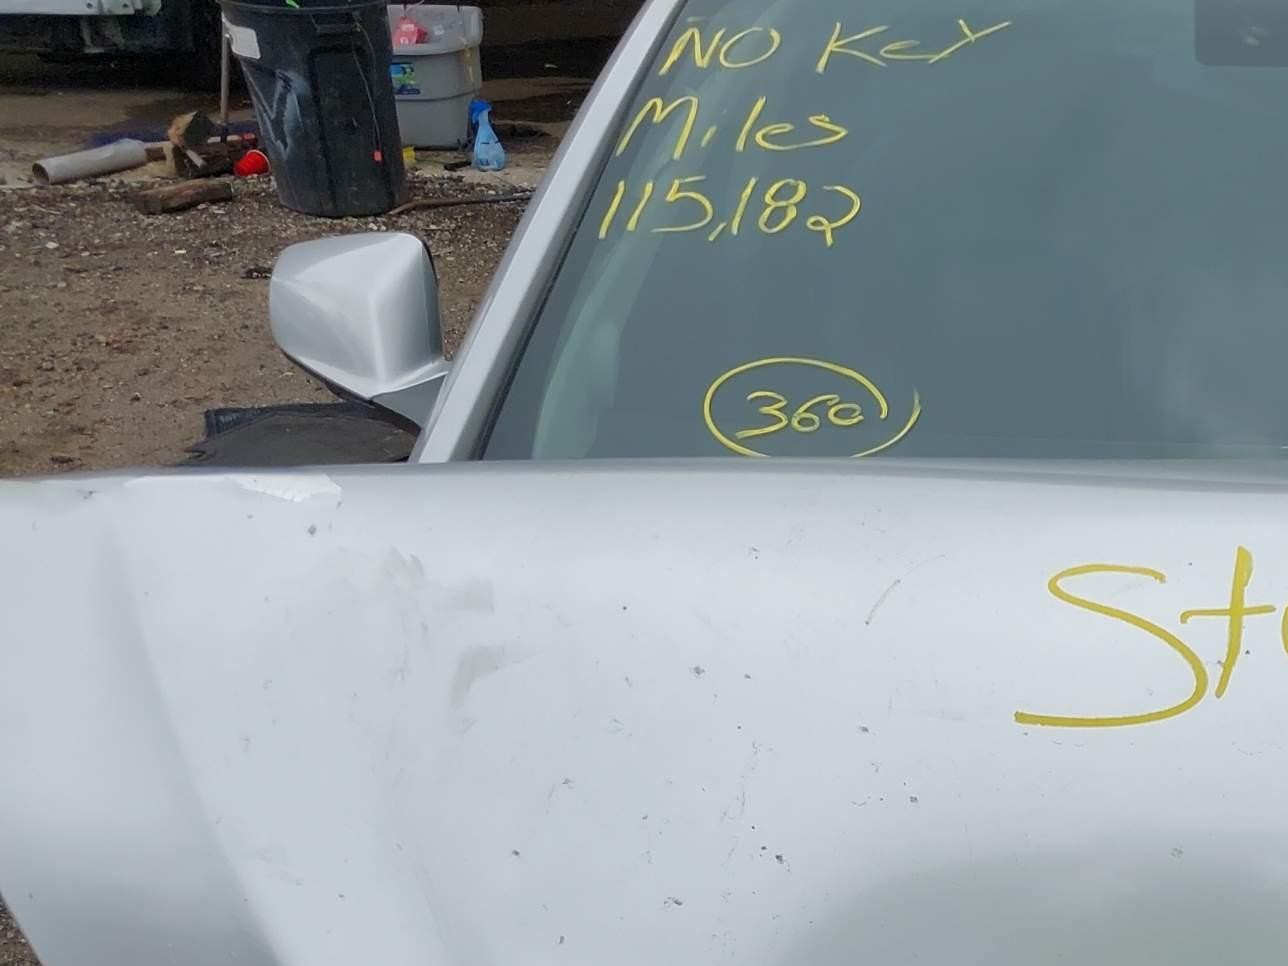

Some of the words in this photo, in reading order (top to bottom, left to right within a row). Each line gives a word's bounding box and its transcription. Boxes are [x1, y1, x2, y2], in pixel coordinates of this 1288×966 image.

[616, 95, 849, 160] Miles
[598, 175, 863, 247] 115,182
[735, 390, 865, 439] 360
